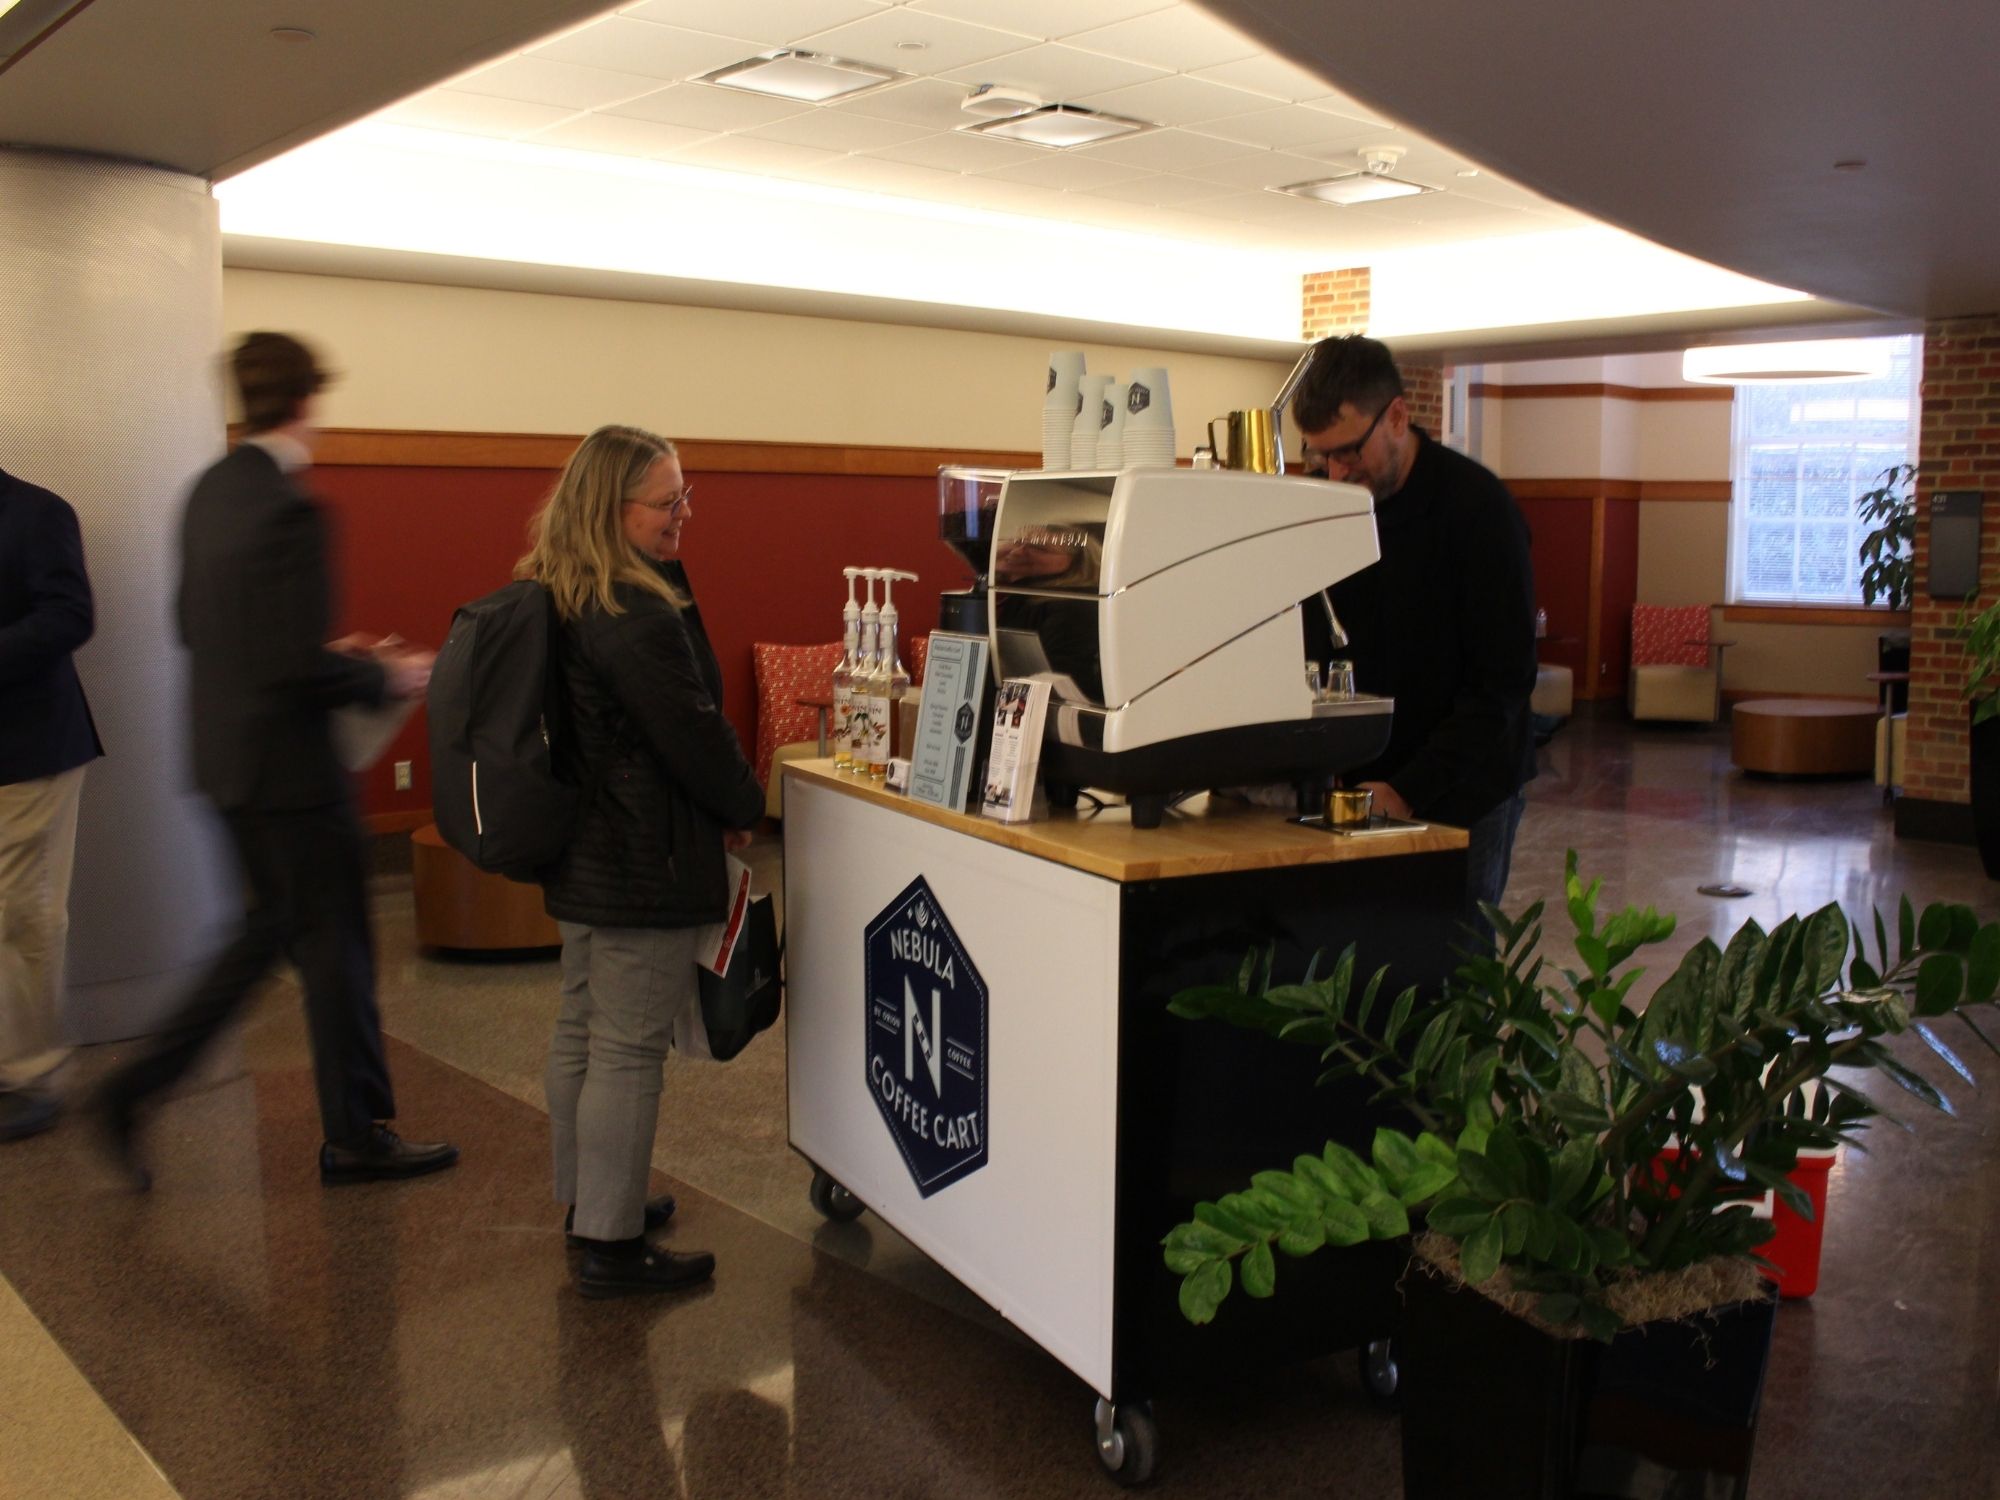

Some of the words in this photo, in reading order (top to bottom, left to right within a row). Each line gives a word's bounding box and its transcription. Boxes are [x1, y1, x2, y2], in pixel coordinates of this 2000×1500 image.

[890, 928, 955, 990] NEBULA
[904, 973, 941, 1100] N
[947, 1046, 972, 1070] COFFEE
[872, 1055, 929, 1140] COFFEE
[933, 1112, 979, 1150] CART
